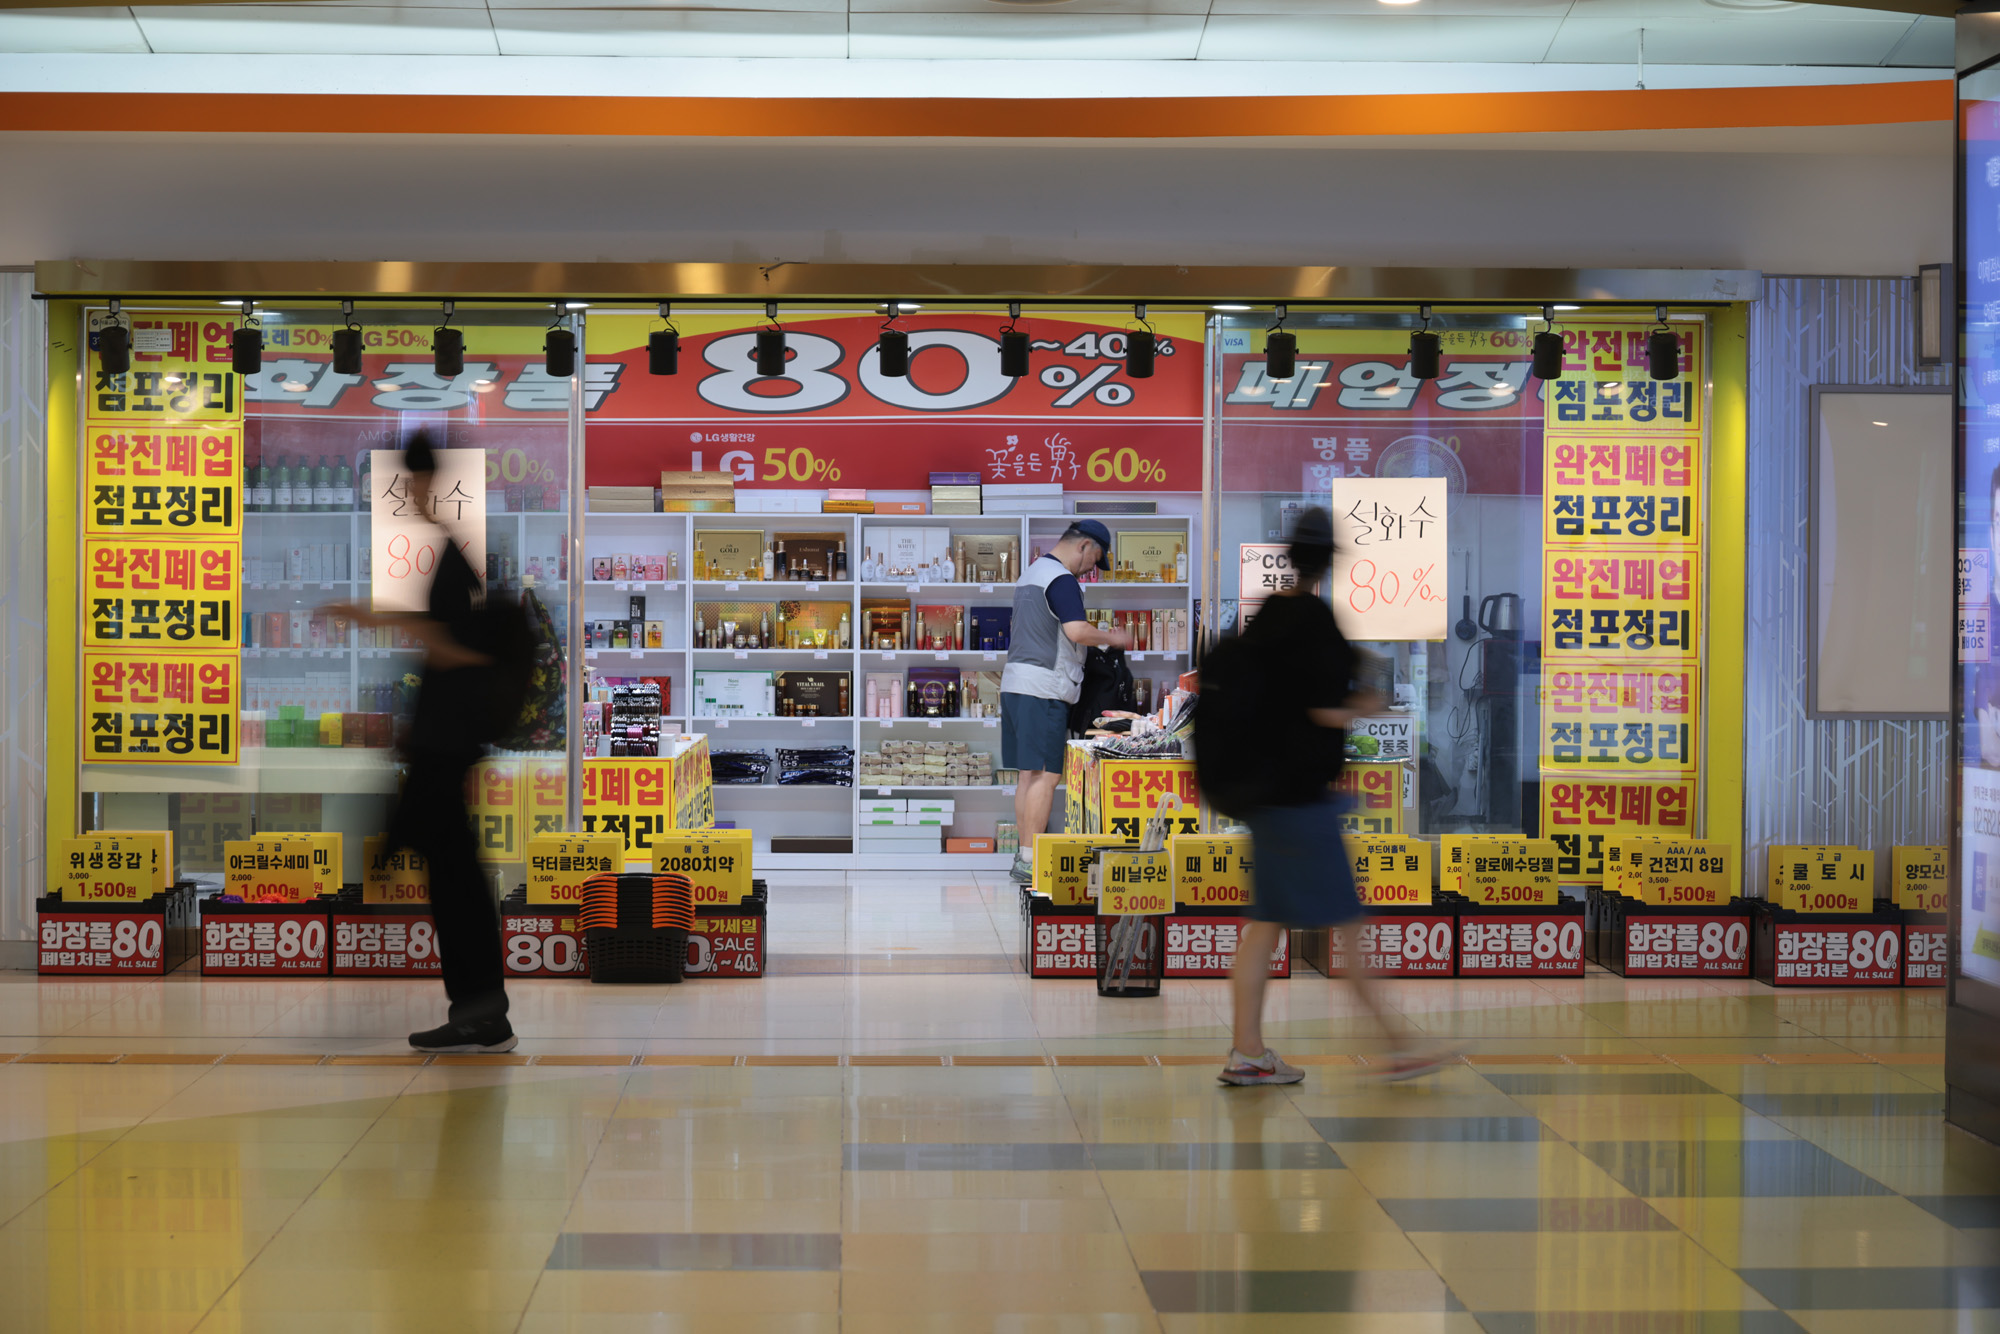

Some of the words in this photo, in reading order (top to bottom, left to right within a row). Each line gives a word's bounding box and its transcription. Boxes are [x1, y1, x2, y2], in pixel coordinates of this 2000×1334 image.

[292, 329, 333, 346] 50%
[386, 329, 429, 347] 50%
[1224, 338, 1244, 347] VISA
[1490, 331, 1533, 348] 60%
[95, 371, 234, 413] 점포정리
[1225, 361, 1544, 411] 폐업정
[1555, 380, 1693, 422] 점포정리
[704, 432, 756, 443] LG생활건강
[95, 434, 233, 477] 완전폐업
[1312, 437, 1371, 461] 명품
[485, 448, 555, 483] 50%
[761, 447, 841, 482] 50%
[1086, 447, 1167, 483] 60%
[1554, 444, 1692, 487] 완전폐업
[94, 485, 232, 527] 점포정리
[1553, 495, 1691, 537] 점포정리
[93, 548, 231, 591] 완전폐업
[1262, 574, 1300, 591] 작동
[1552, 558, 1690, 600] 완전폐업
[92, 598, 231, 640] 점포정리
[1551, 609, 1690, 650] 점포정리
[91, 661, 230, 704] 완전폐업
[1551, 672, 1689, 714] 완전폐업
[91, 712, 230, 754] 점포정리
[1368, 723, 1409, 736] CCTV
[1550, 722, 1688, 763] 점포정리
[1111, 770, 1200, 809] 완전폐
[1550, 784, 1687, 826] 완전폐업
[1667, 847, 1685, 855] AAA
[1694, 847, 1706, 855] AA
[70, 852, 142, 869] 위생장갑
[230, 854, 309, 870] 아크릴수세미
[371, 854, 426, 871] 샤워타
[532, 856, 612, 872] 닥터클린칫솔
[660, 856, 734, 873] 2080치약
[1475, 857, 1553, 872] 알로에수딩젤
[1649, 857, 1693, 873] 건전지
[1699, 857, 1723, 873] 8입
[68, 872, 90, 880] 3,000
[1112, 865, 1167, 883] 비닐우산
[78, 882, 136, 899] 1,500원
[241, 883, 299, 900] 1,000원
[379, 884, 428, 901] 1,500
[550, 885, 581, 900] 500
[1191, 886, 1249, 903] 1,000원
[1357, 885, 1418, 904] 3,000원
[1484, 886, 1543, 903] 2,500원
[1658, 886, 1715, 903] 1,500원
[1113, 895, 1165, 911] 3,000원
[1799, 893, 1858, 910] 1,000원
[506, 918, 553, 932] 화장품
[694, 919, 757, 934] 특가세일
[41, 920, 112, 950] 화장품
[112, 920, 161, 959] 80%
[205, 921, 276, 951] 화장품
[276, 920, 326, 959] 80%
[336, 921, 406, 951] 화장품
[714, 938, 755, 951] SALE
[1167, 922, 1238, 953] 화장품
[1402, 922, 1452, 960] 80%
[1462, 922, 1533, 952] 화장품
[1533, 921, 1582, 960] 80%
[1628, 922, 1699, 952] 화장품
[1698, 922, 1748, 960] 80%
[506, 934, 585, 972] 80%
[1778, 930, 1848, 961] 화장품
[1848, 930, 1899, 970] 80%
[40, 952, 112, 967] 폐업처분
[117, 960, 133, 968] ALL
[135, 960, 157, 968] SALE
[205, 952, 276, 967] 폐업처분
[282, 961, 297, 969] ALL
[299, 961, 321, 969] SALE
[336, 953, 406, 968] 폐업처분
[1332, 954, 1402, 969] 폐처분
[1407, 962, 1423, 970] ALL
[1425, 962, 1447, 970] SALE
[1462, 953, 1533, 969] 폐업처분
[1628, 954, 1698, 968] 폐업처분
[1704, 962, 1719, 970] ALL
[1721, 962, 1743, 970] SALE
[1777, 962, 1848, 978] 폐업처분
[1854, 971, 1870, 979] ALL
[1872, 971, 1894, 979] SALE
